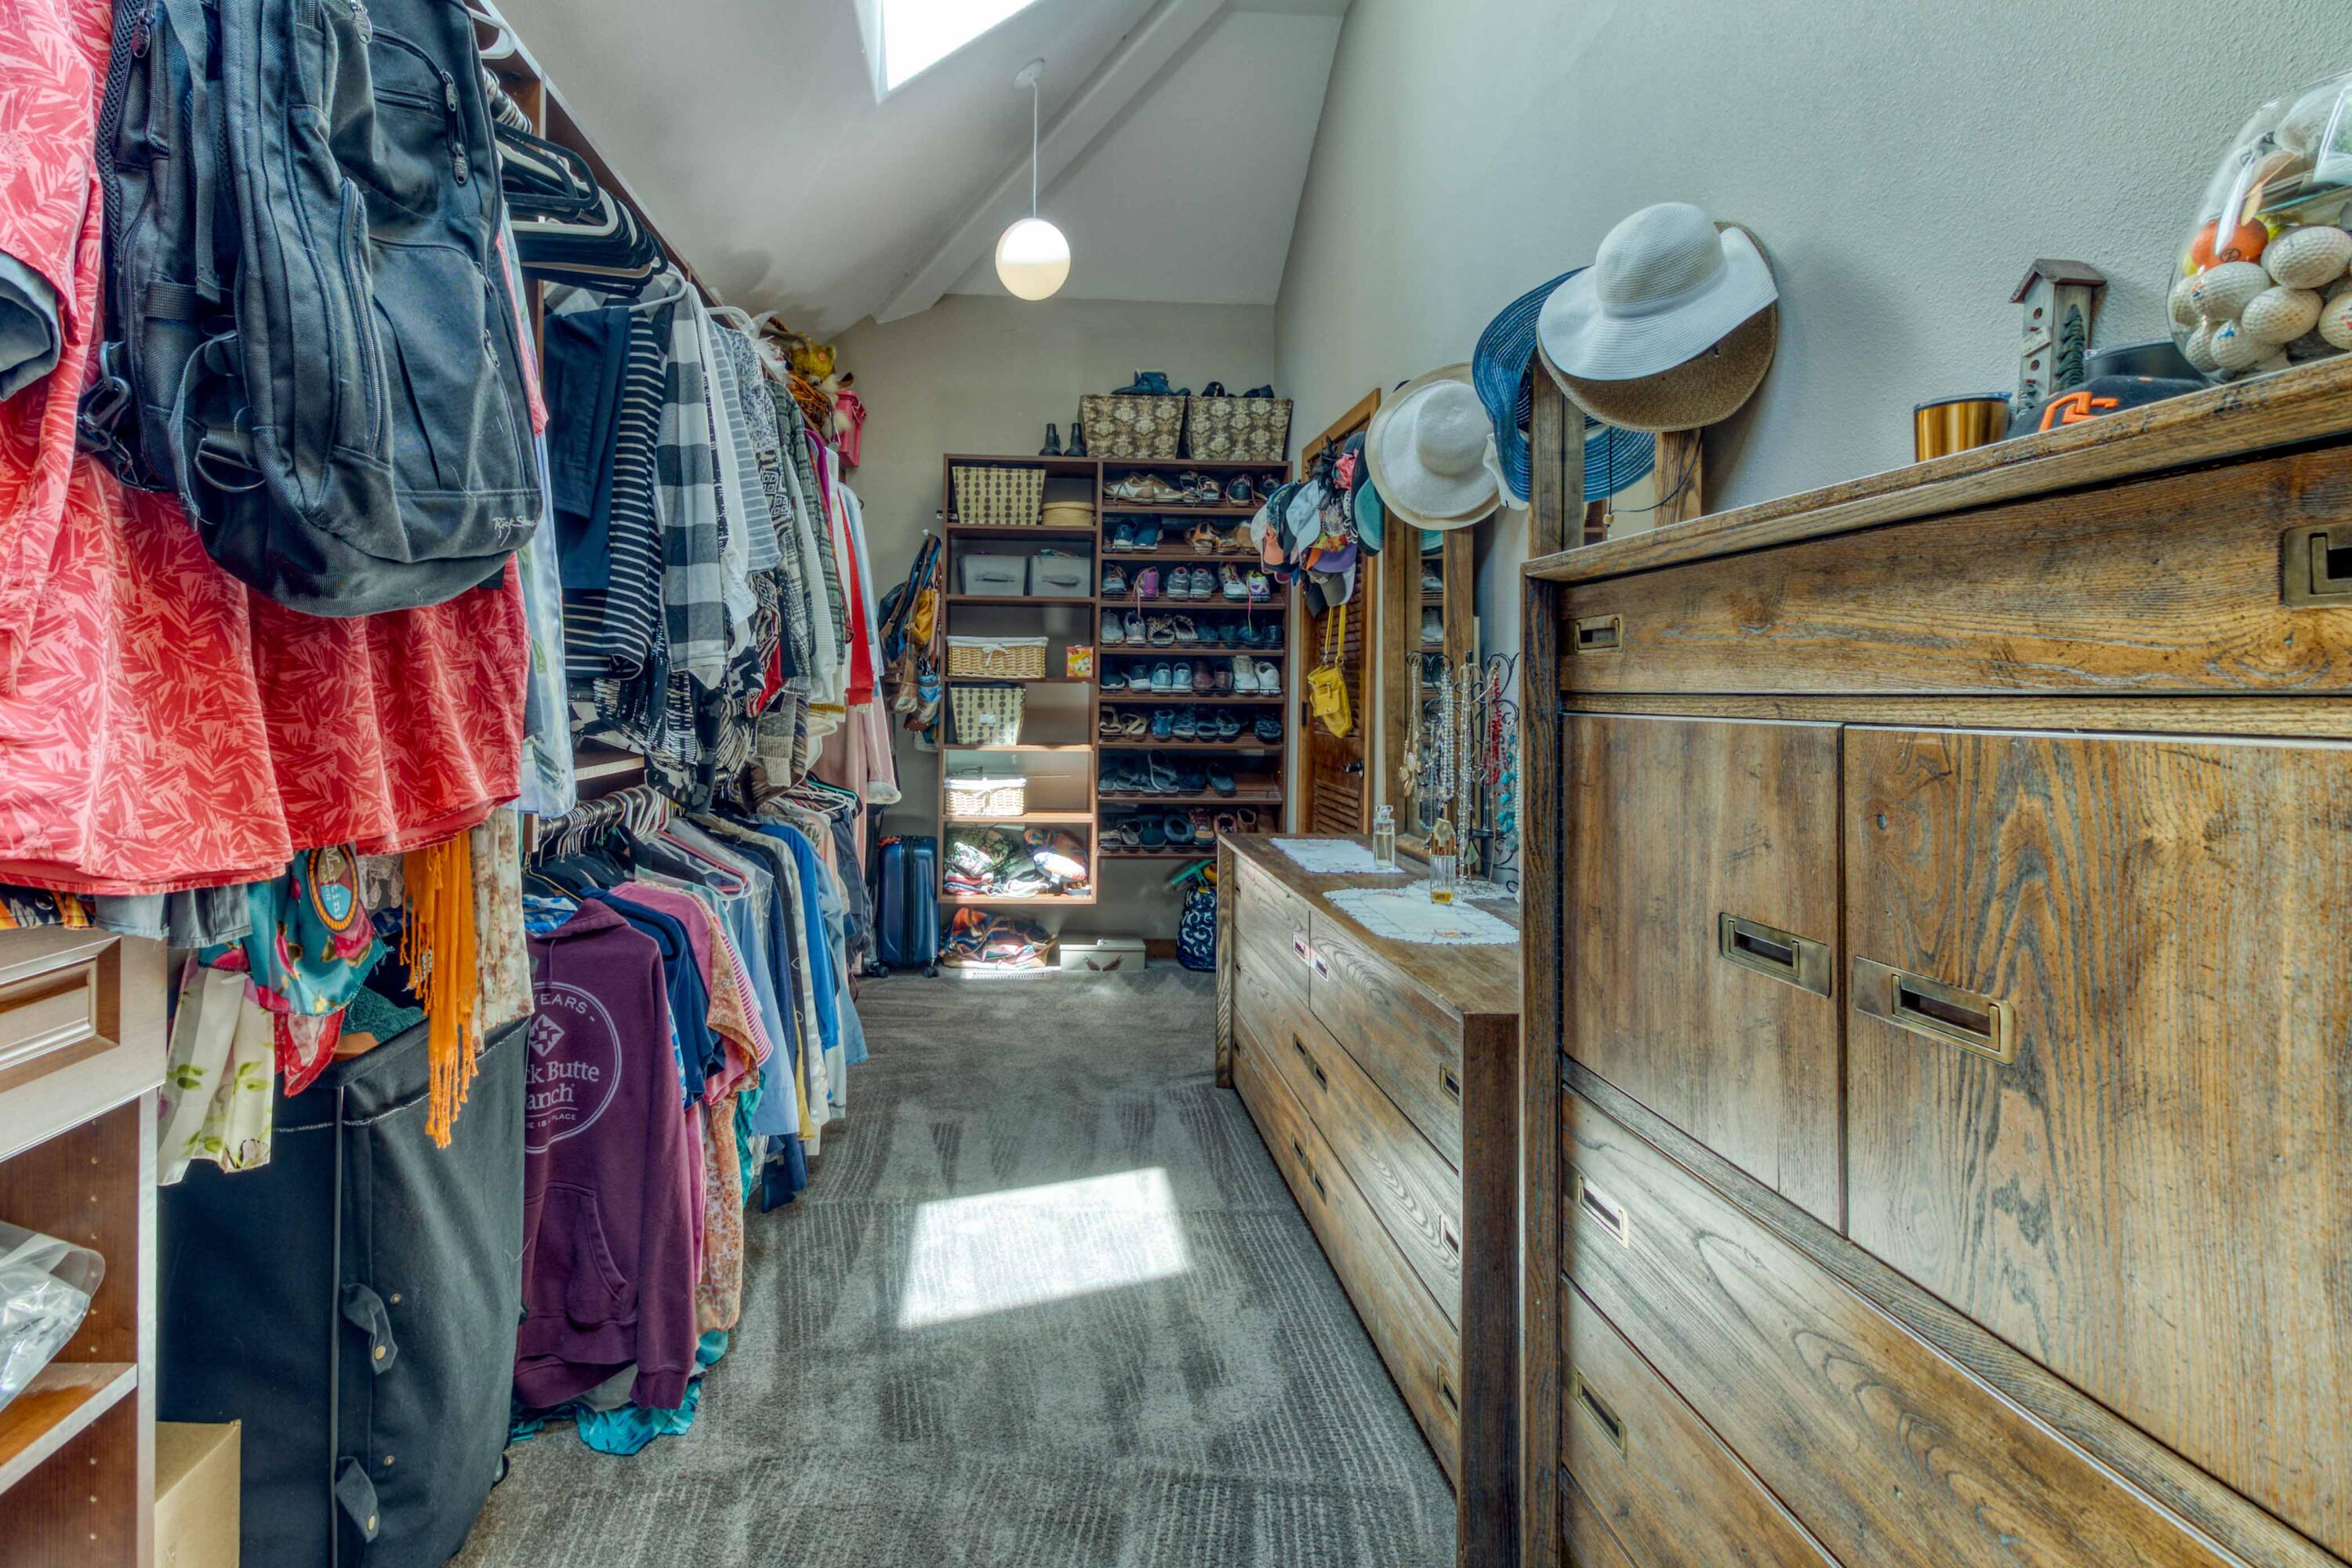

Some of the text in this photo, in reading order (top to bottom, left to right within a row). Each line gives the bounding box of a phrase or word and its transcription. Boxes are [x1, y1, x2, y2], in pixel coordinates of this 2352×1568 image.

[492, 517, 515, 546] Rick
[546, 1060, 600, 1082] Butte
[525, 1082, 575, 1110] anch
